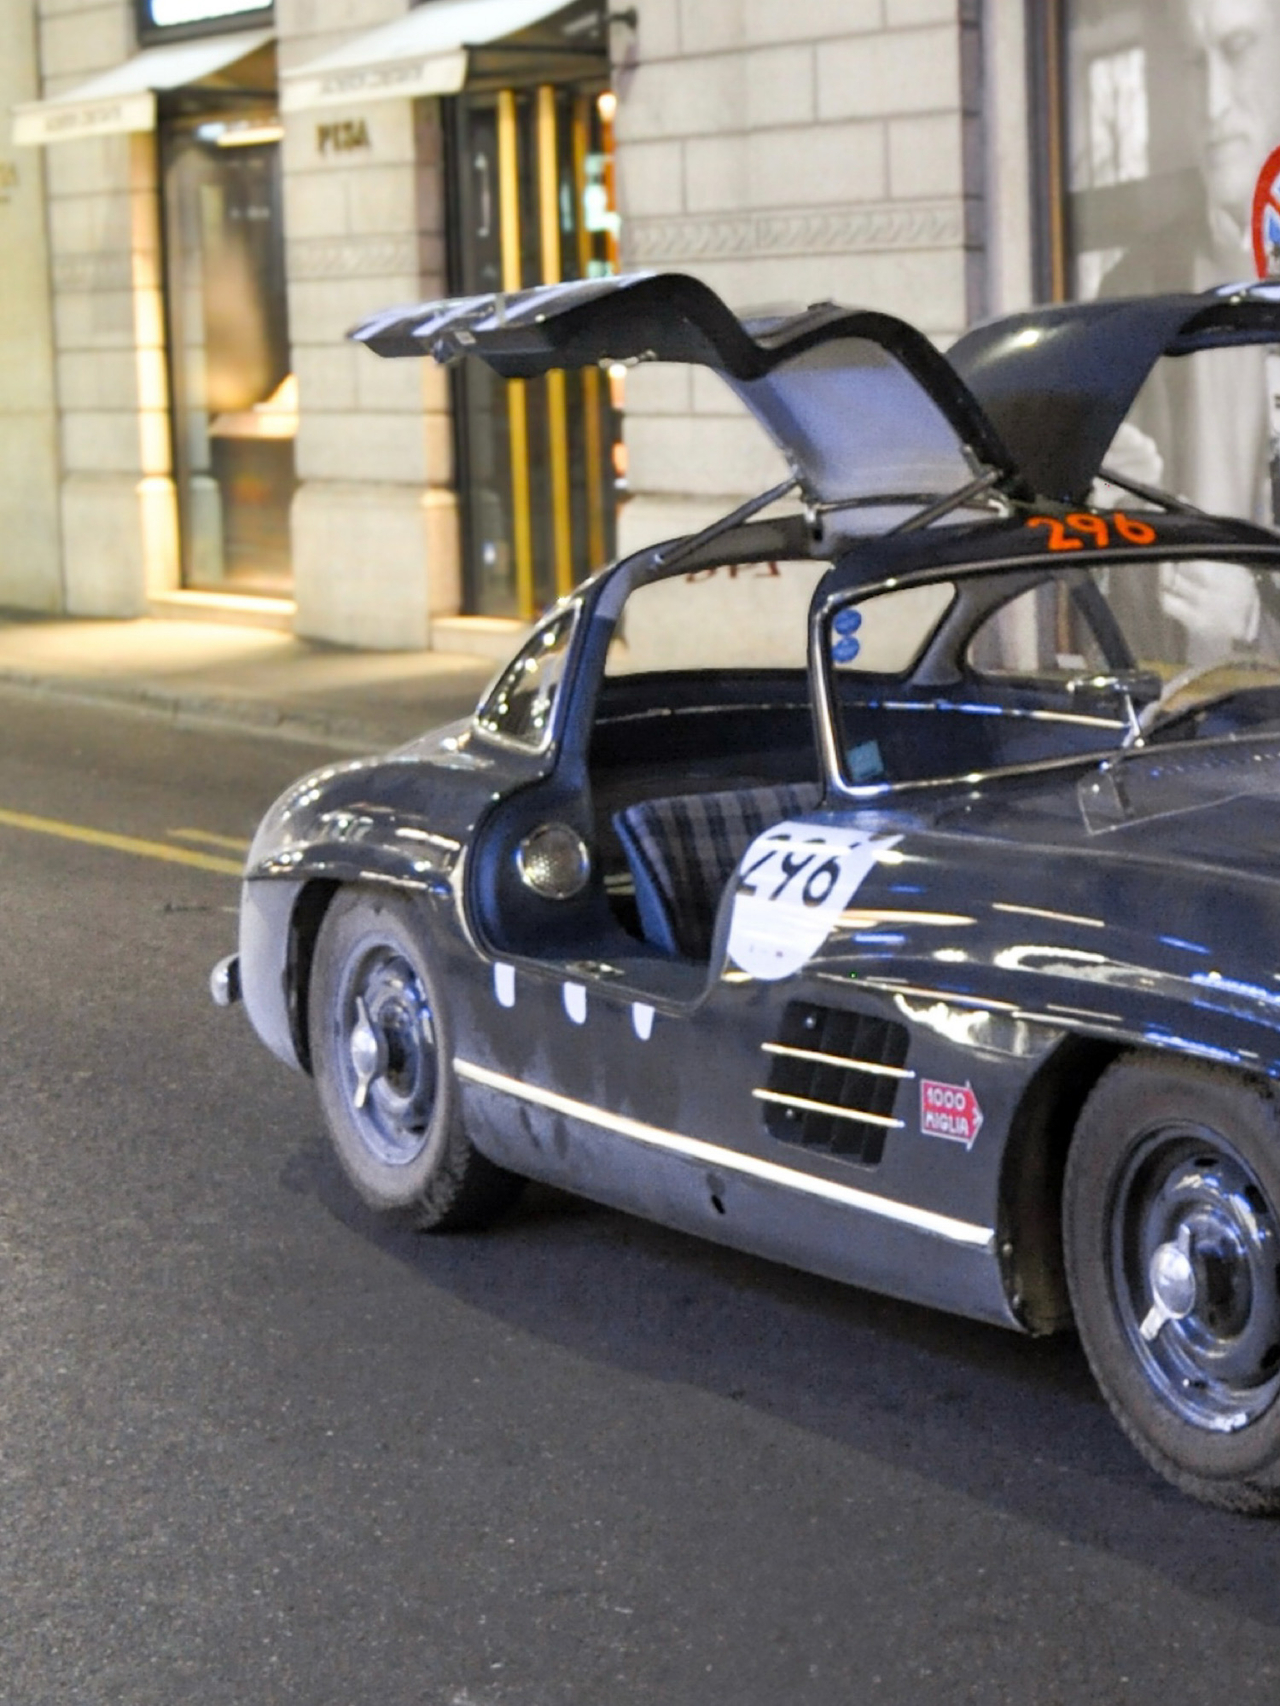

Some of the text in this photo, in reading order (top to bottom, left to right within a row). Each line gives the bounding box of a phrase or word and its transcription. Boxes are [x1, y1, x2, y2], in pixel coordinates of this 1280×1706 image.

[1026, 510, 1157, 551] 296
[926, 1086, 966, 1112] 1000
[925, 1111, 970, 1138] MIGLIA
